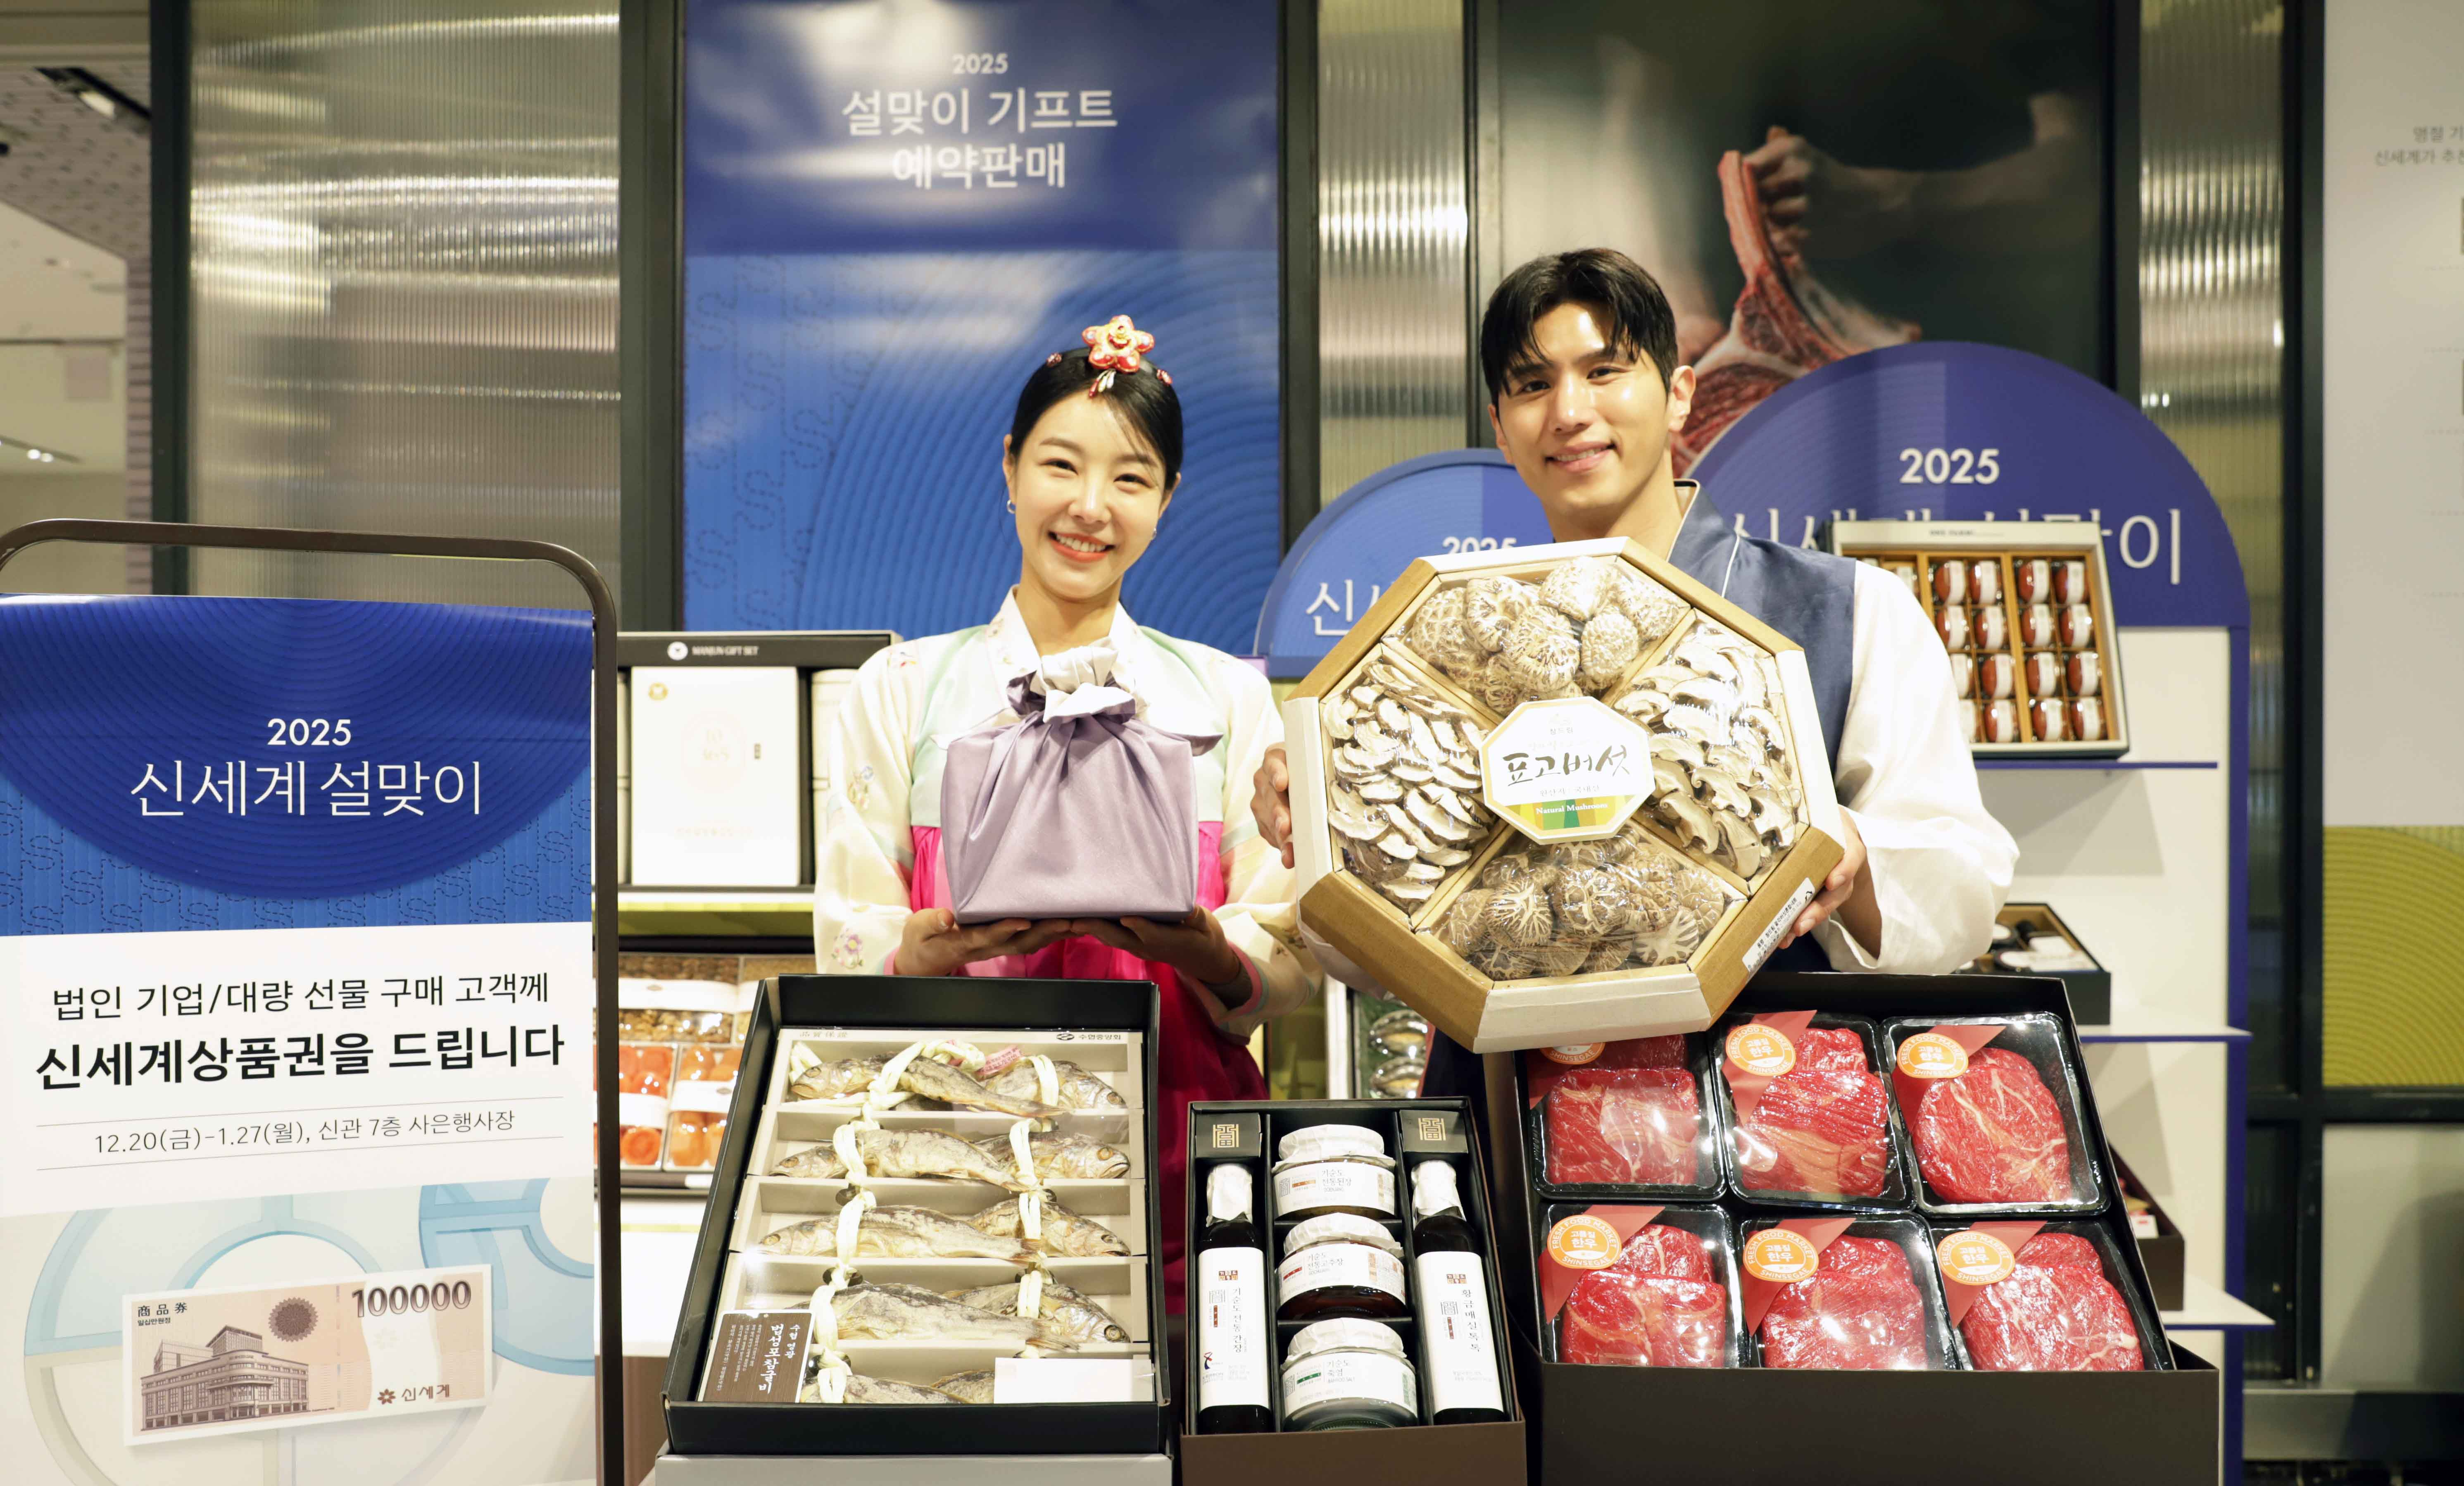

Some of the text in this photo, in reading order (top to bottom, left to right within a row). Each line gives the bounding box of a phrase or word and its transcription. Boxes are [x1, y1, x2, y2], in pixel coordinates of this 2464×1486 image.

[952, 53, 1008, 74] 2025
[842, 87, 1118, 136] 설맞이 기프트
[892, 143, 1065, 189] 예약판매
[1900, 448, 2000, 484] 2025
[267, 719, 351, 746] 2025
[1503, 745, 1629, 786] 표고버섯
[131, 760, 480, 817] 신세계 설맞이
[1536, 804, 1565, 814] Natural
[53, 973, 549, 1020] 법인 기업/대량 선물 구매 고객께
[36, 1024, 564, 1090] 신세계상품권을 드립니다
[1550, 1050, 1595, 1061] SHINSEGAE
[1730, 1027, 1791, 1058] FRESH FOOD MARKET
[1749, 1046, 1774, 1057] 한우
[1900, 1044, 1912, 1065] FRESH
[1938, 1037, 1963, 1060] MARKET
[94, 1110, 515, 1154] 12.20(금)-1.27(월), 신관 7층 사은행사장
[1552, 1218, 1617, 1249] FRESH FOOD MARKET
[1572, 1238, 1597, 1248] 한우
[1747, 1232, 1814, 1264] FRESH FOOD MARKET
[1562, 1256, 1610, 1265] SHINSEGAE
[1767, 1252, 1793, 1262] 한우
[1942, 1234, 2009, 1265] FRESH FOOD MARKET
[1962, 1254, 1989, 1265] 한우
[1760, 1268, 1810, 1279] SHINSEGAE
[1957, 1268, 2007, 1281] SHINSEGAE
[138, 1303, 187, 1317] 商品券
[351, 1281, 471, 1318] 100000
[785, 1324, 800, 1359] 수협 영광
[759, 1324, 783, 1395] 법성포참굴비
[401, 1384, 450, 1401] 신세계
